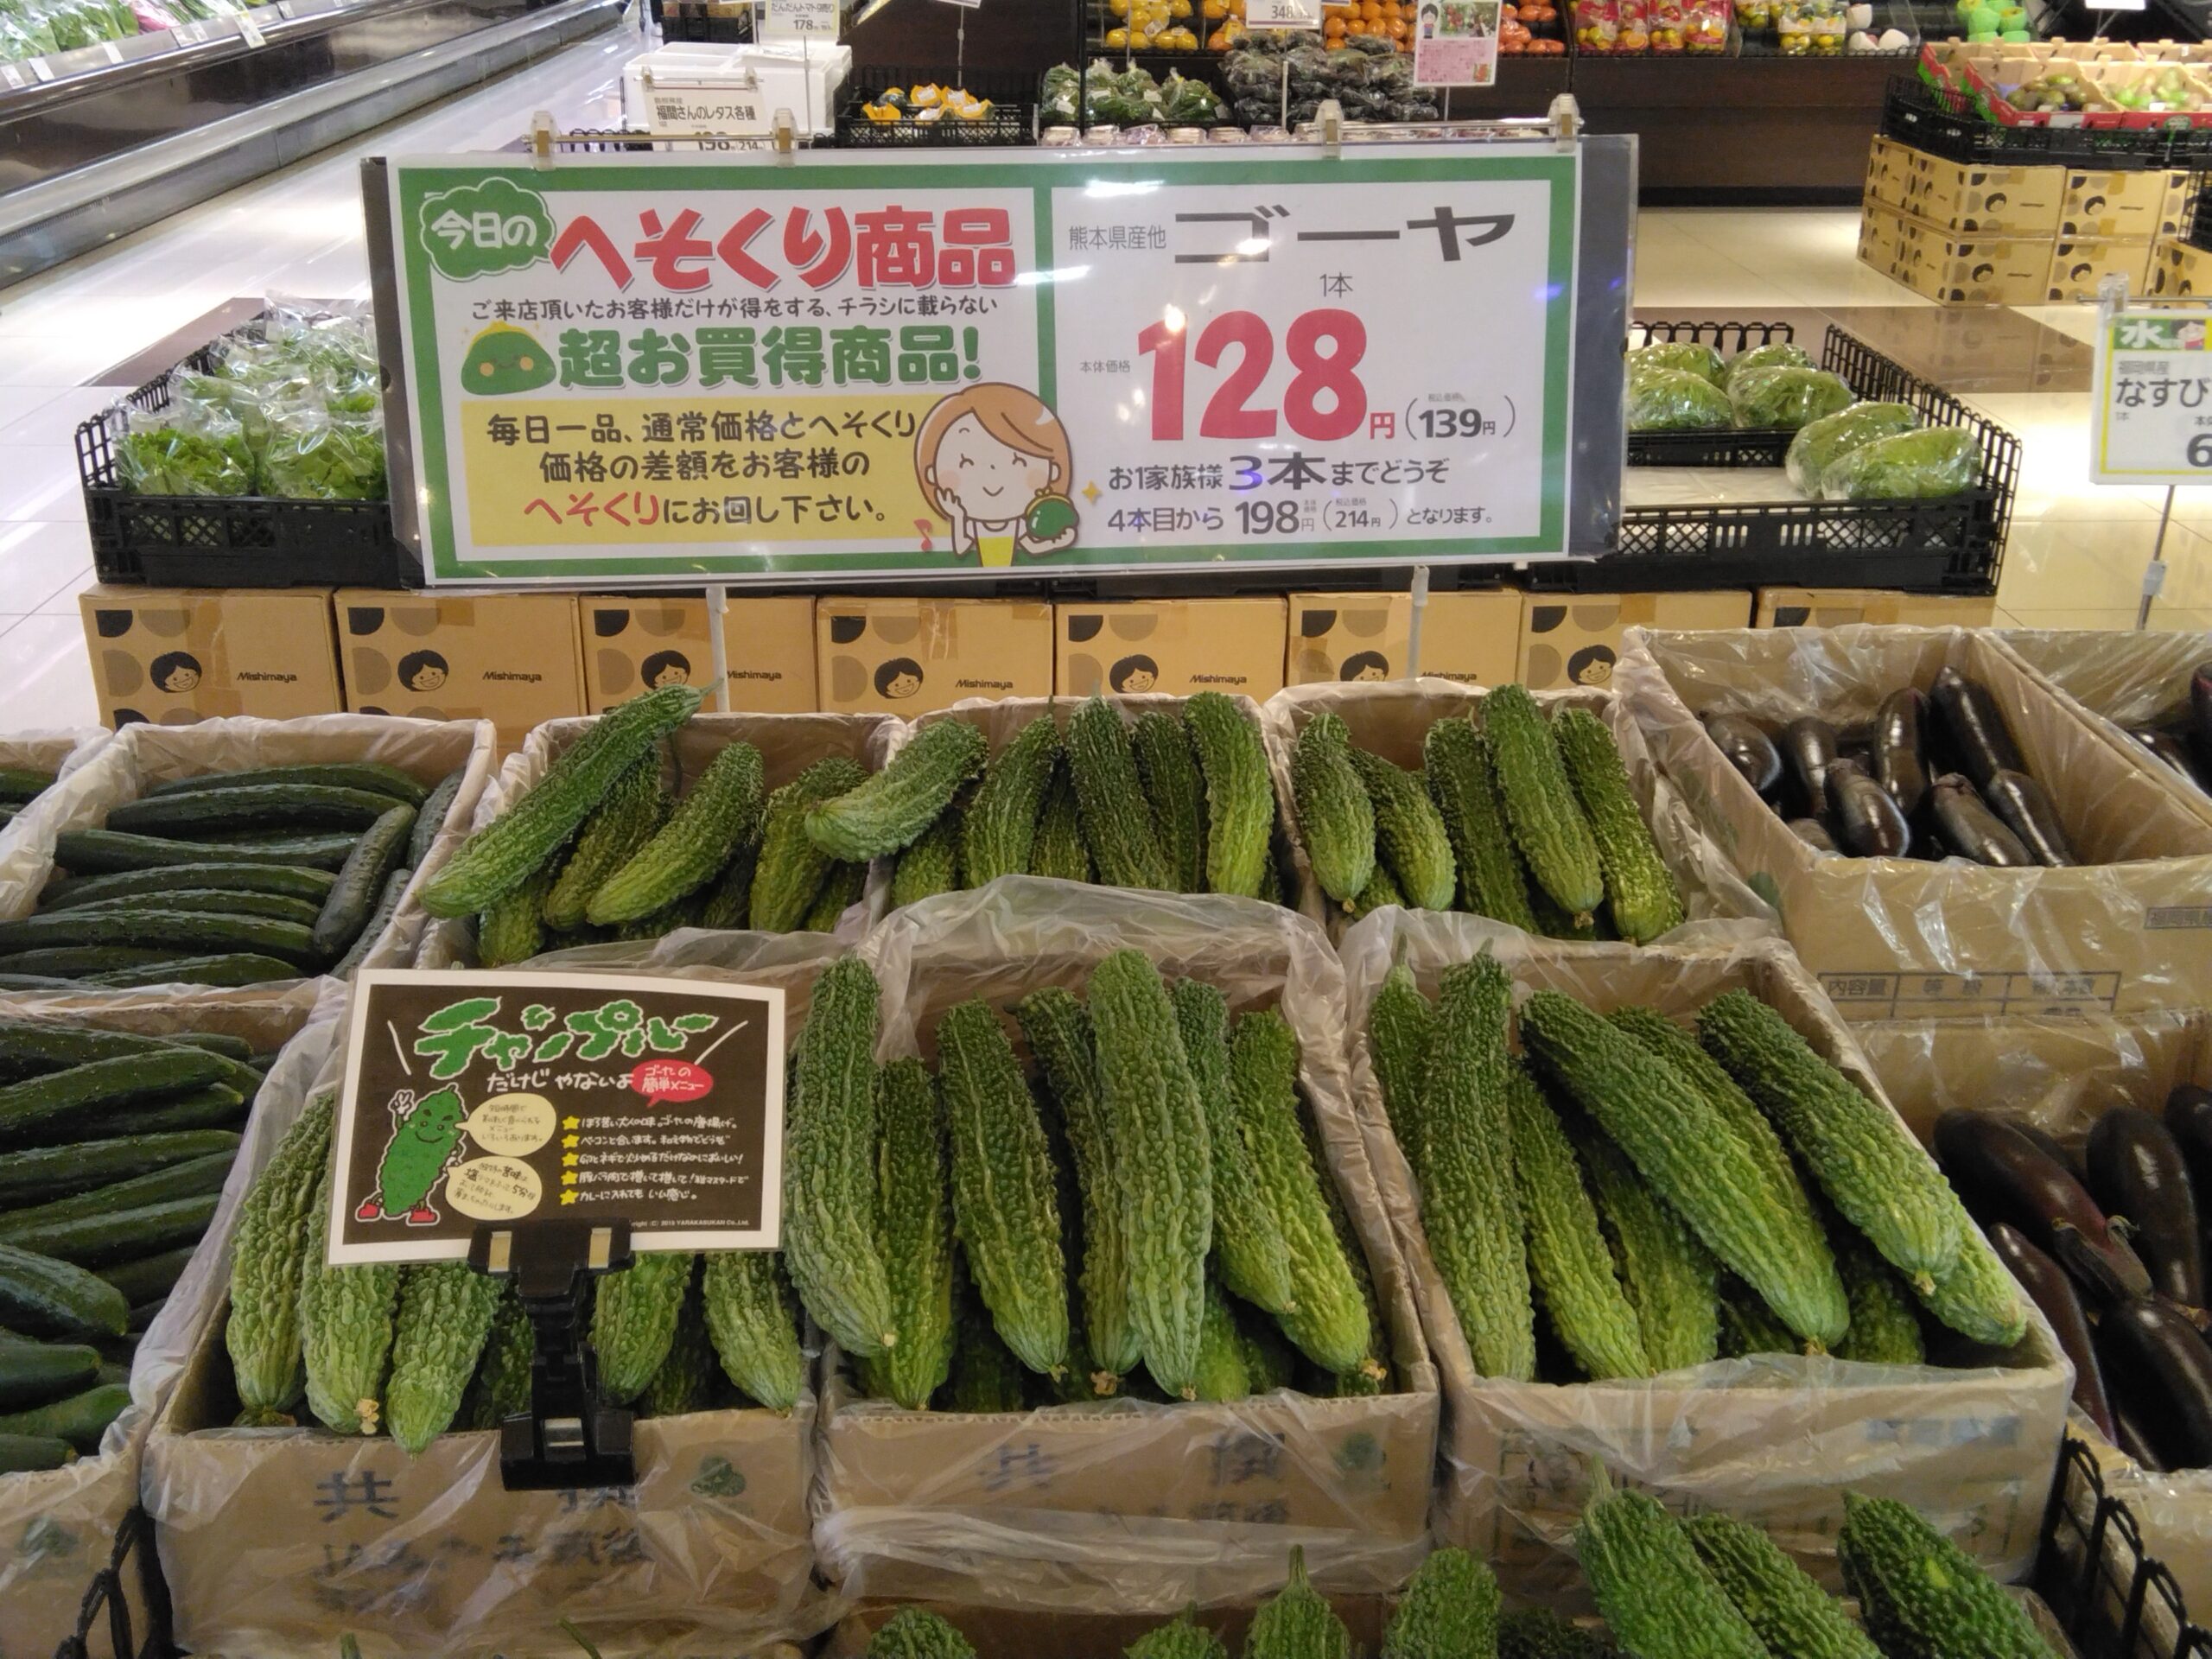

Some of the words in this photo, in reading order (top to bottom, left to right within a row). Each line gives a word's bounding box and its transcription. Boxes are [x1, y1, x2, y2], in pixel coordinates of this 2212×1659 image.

[657, 105, 756, 120] 福間さんのレタス各種
[1068, 225, 1167, 251] 熊本県産他
[1174, 204, 1516, 263] ゴーヤ
[429, 211, 537, 250] 今日の
[550, 205, 1016, 291] へそくり商品
[1319, 271, 1353, 299] 1本
[472, 296, 998, 322] ご来店頂いたお客様だけが得をする、チラシに載らない
[558, 324, 982, 390] 超お買得商品!
[1080, 359, 1131, 374] 本体価格
[2116, 377, 2211, 408] なすび
[486, 410, 916, 446] 毎日一品、通常価格とへそくり
[539, 450, 869, 483] 価格の差額をお客様の
[238, 671, 297, 683] Mishimaya
[482, 671, 543, 683] Mishimaya
[955, 678, 1014, 690] Mishimaya
[1189, 674, 1248, 685] Mishimaya
